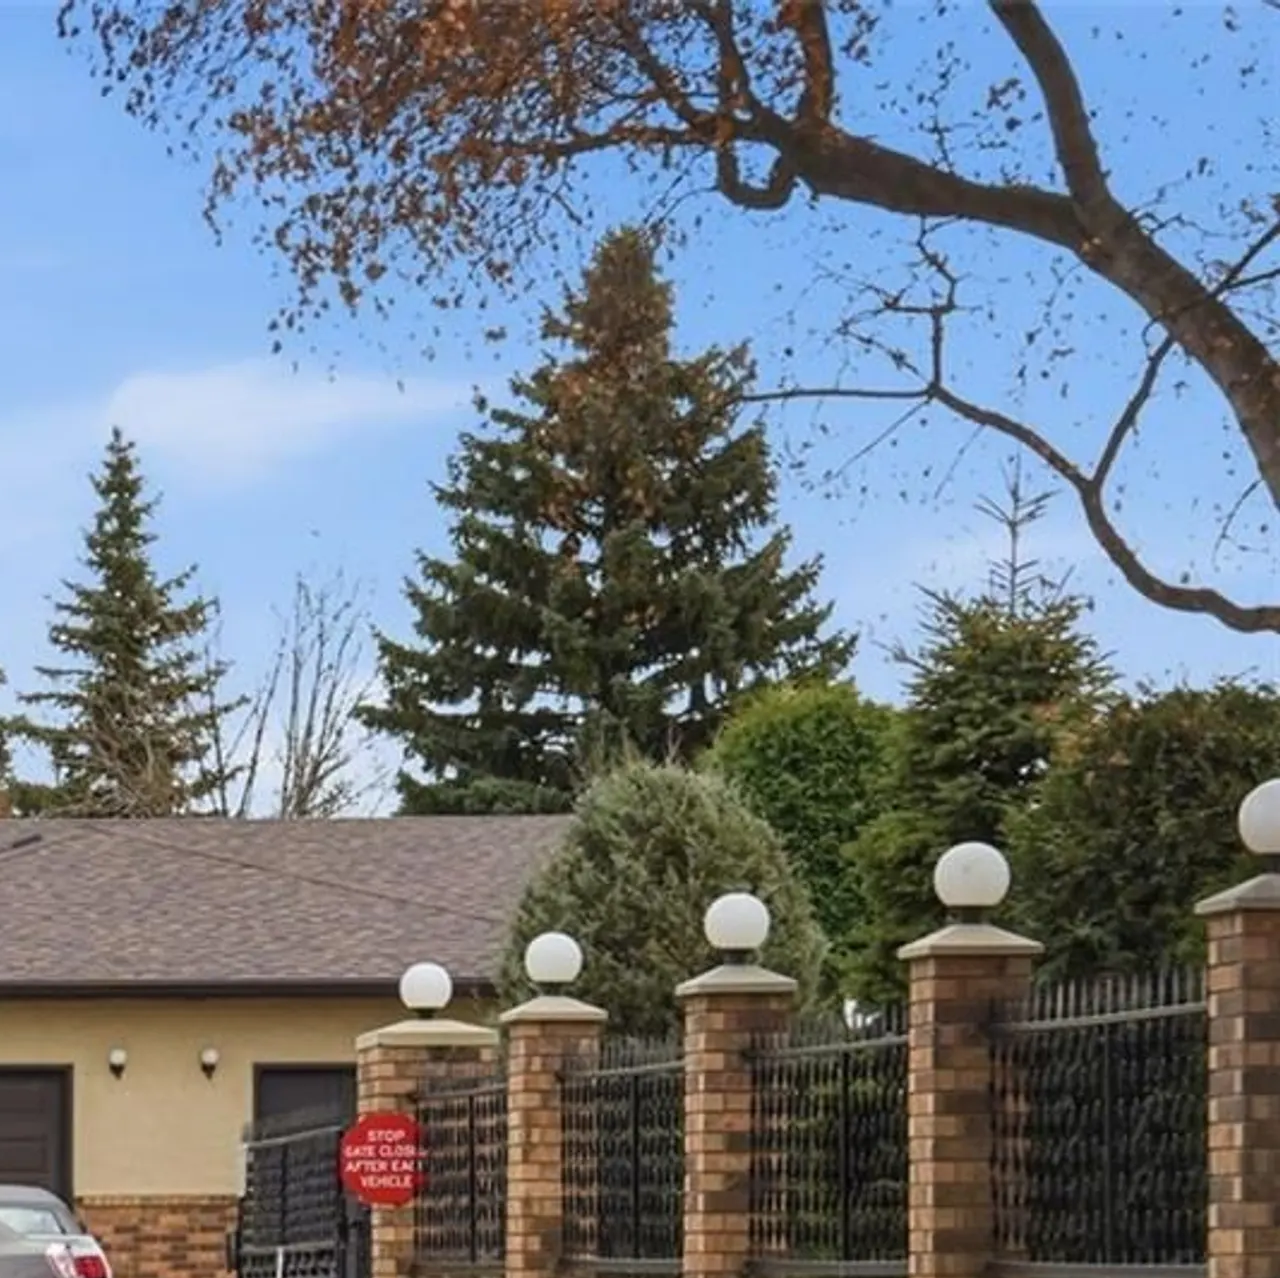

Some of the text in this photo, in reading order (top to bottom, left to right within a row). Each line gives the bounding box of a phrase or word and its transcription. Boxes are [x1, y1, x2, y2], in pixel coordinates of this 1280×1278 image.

[367, 1129, 406, 1142] STOP
[344, 1159, 388, 1173] AFTER
[360, 1174, 414, 1188] VEHICLE
